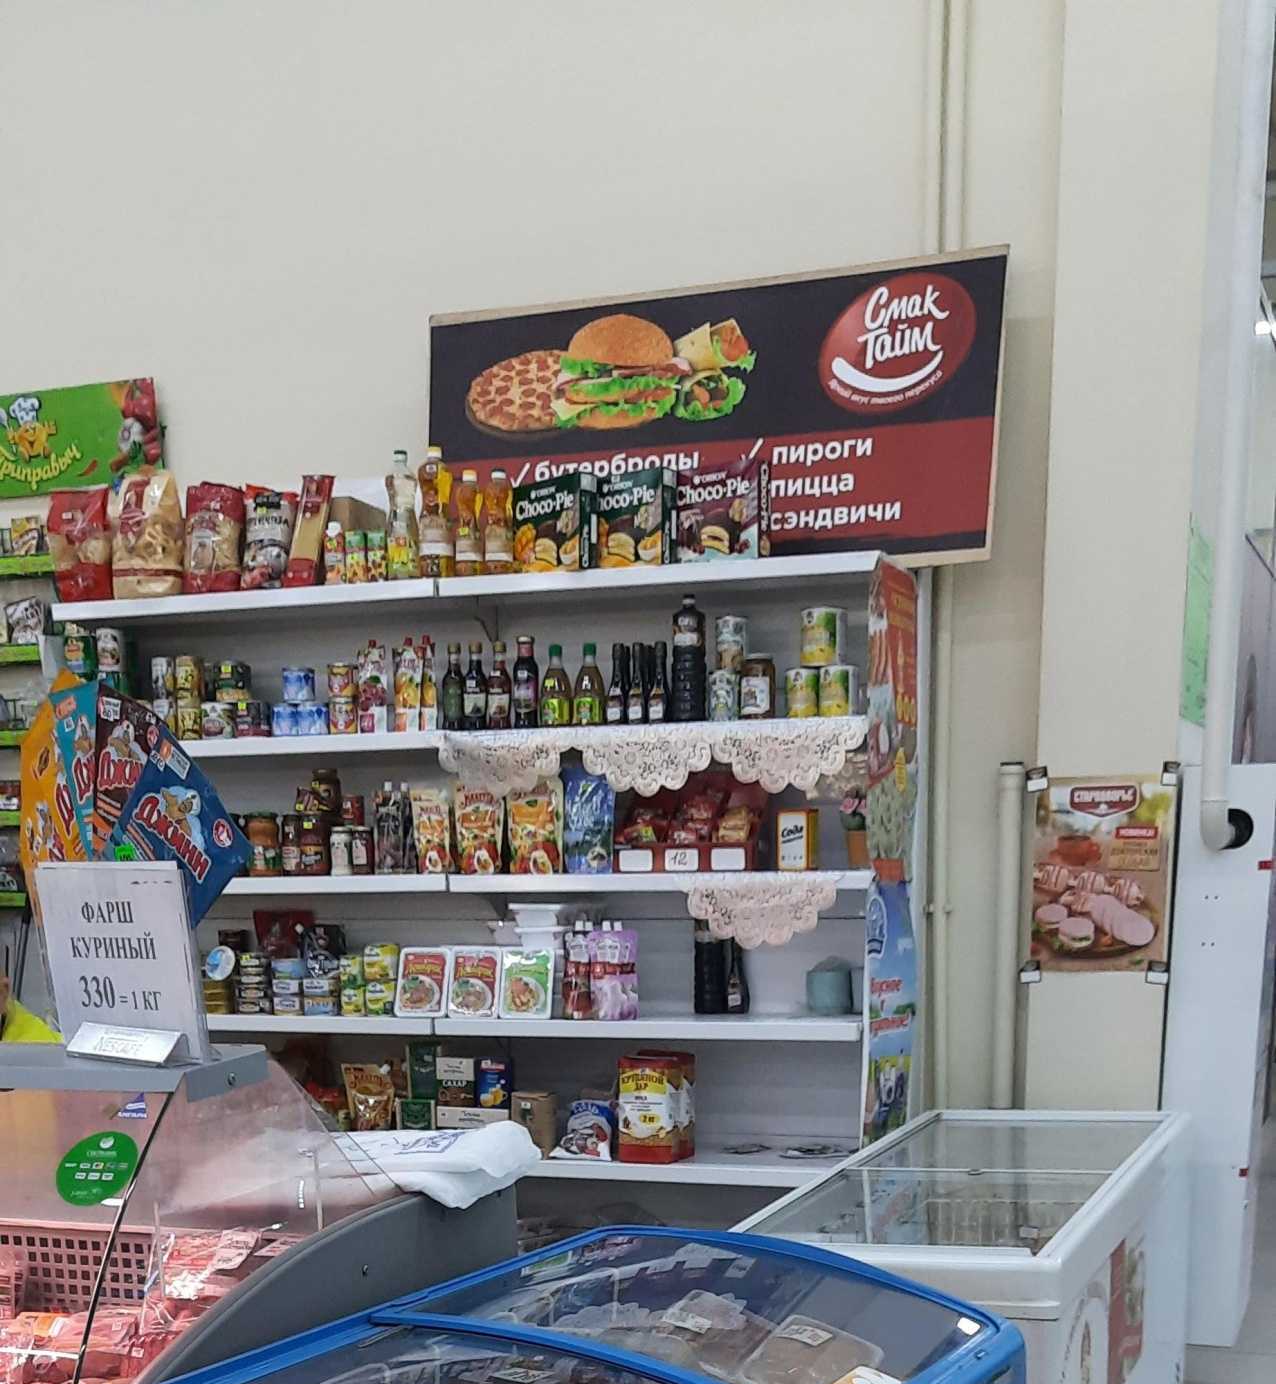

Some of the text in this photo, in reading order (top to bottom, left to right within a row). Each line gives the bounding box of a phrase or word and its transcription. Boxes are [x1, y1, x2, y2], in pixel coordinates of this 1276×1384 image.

[864, 285, 949, 328] Смак
[857, 321, 942, 369] Тайм
[772, 438, 873, 466] пироги
[770, 473, 854, 498] пицца
[770, 501, 901, 532] сэндвичи
[98, 751, 142, 790] ДЖИ
[133, 794, 211, 882] ДЖИНН
[81, 900, 134, 926] ФАРШ
[70, 931, 157, 961] КУРИНЫЙ
[79, 975, 116, 1009] 330
[142, 990, 162, 1011] КГ
